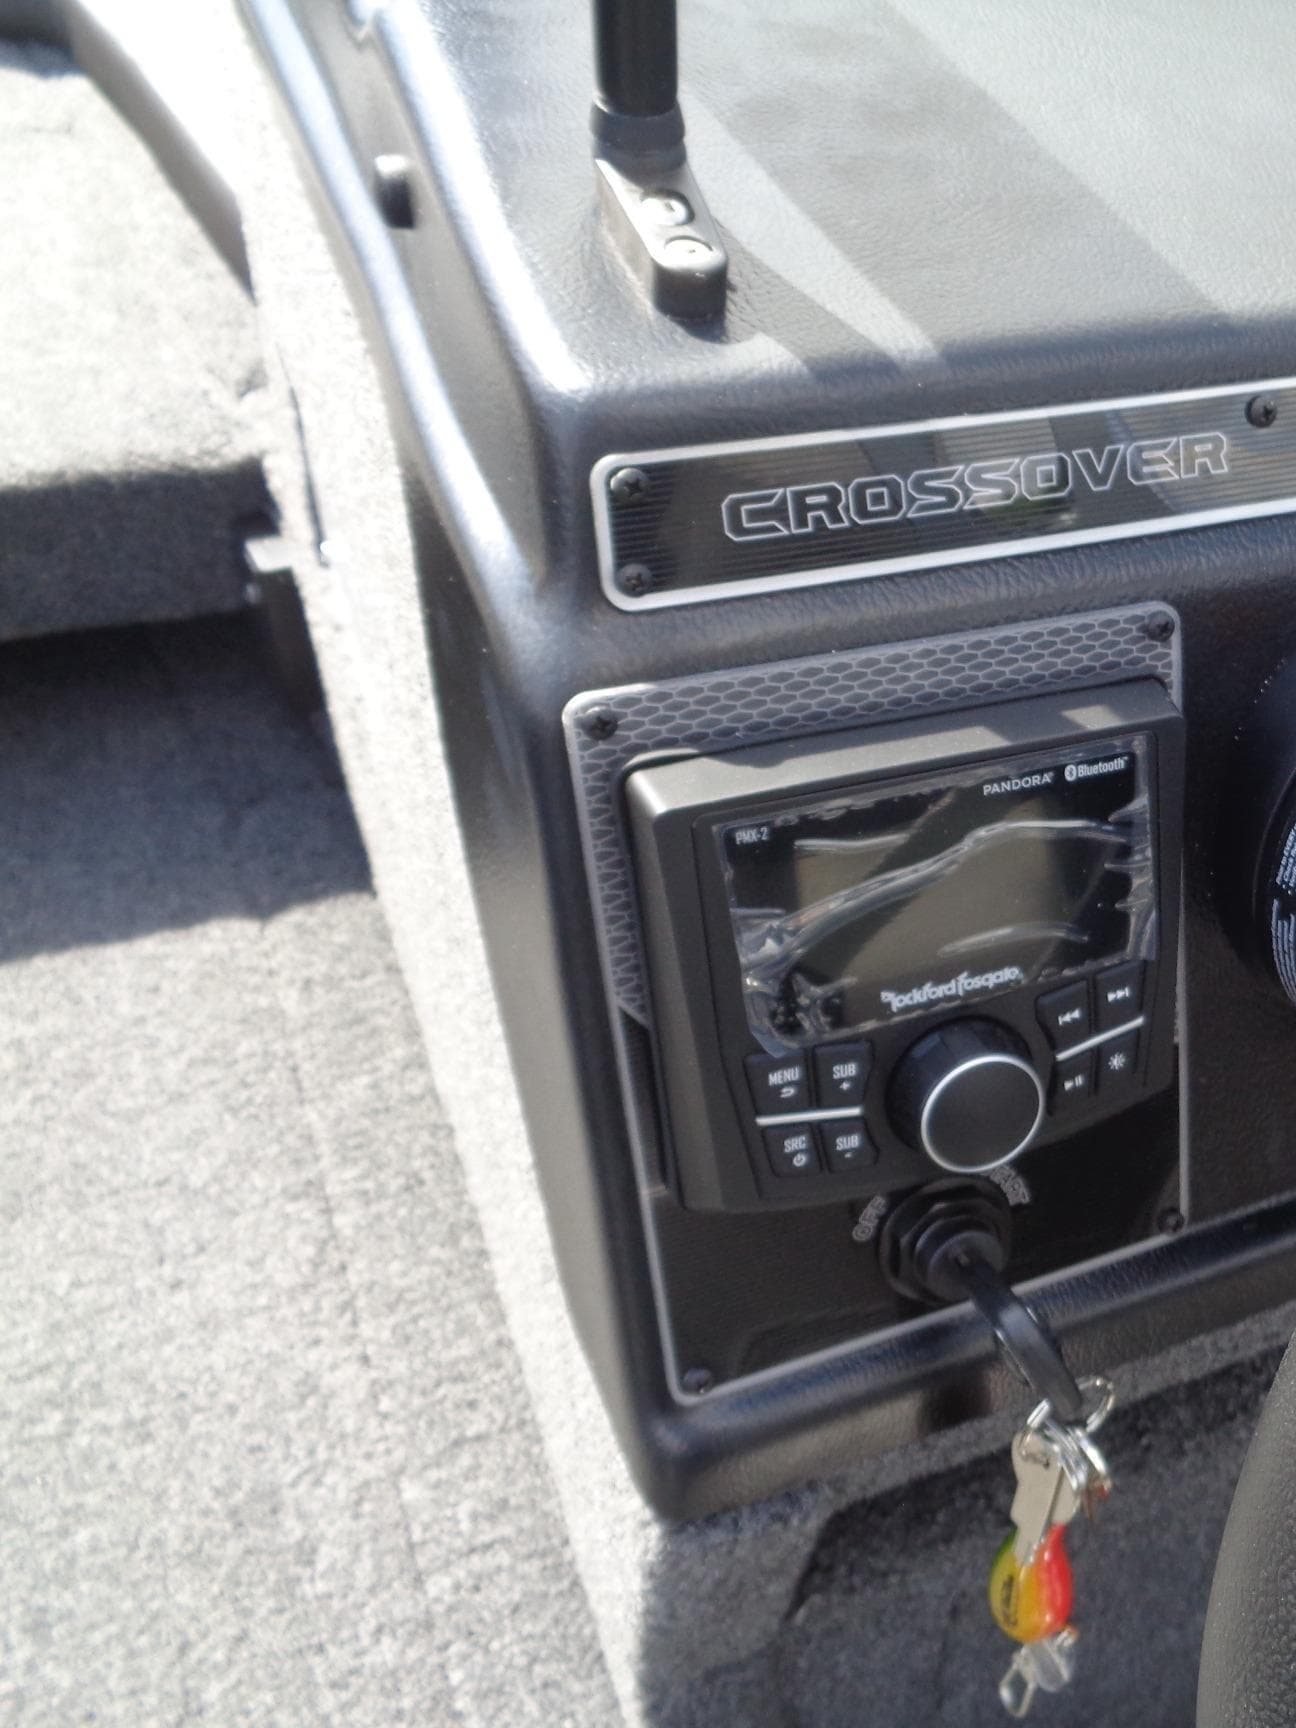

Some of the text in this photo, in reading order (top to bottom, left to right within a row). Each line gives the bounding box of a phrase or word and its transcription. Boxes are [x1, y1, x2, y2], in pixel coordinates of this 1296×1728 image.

[721, 431, 1230, 542] CROSSOVER
[736, 827, 768, 845] PMX-2
[768, 1065, 800, 1087] MENU
[832, 1062, 857, 1080] SUB
[784, 1136, 806, 1153] SRC
[836, 1134, 858, 1151] SUB
